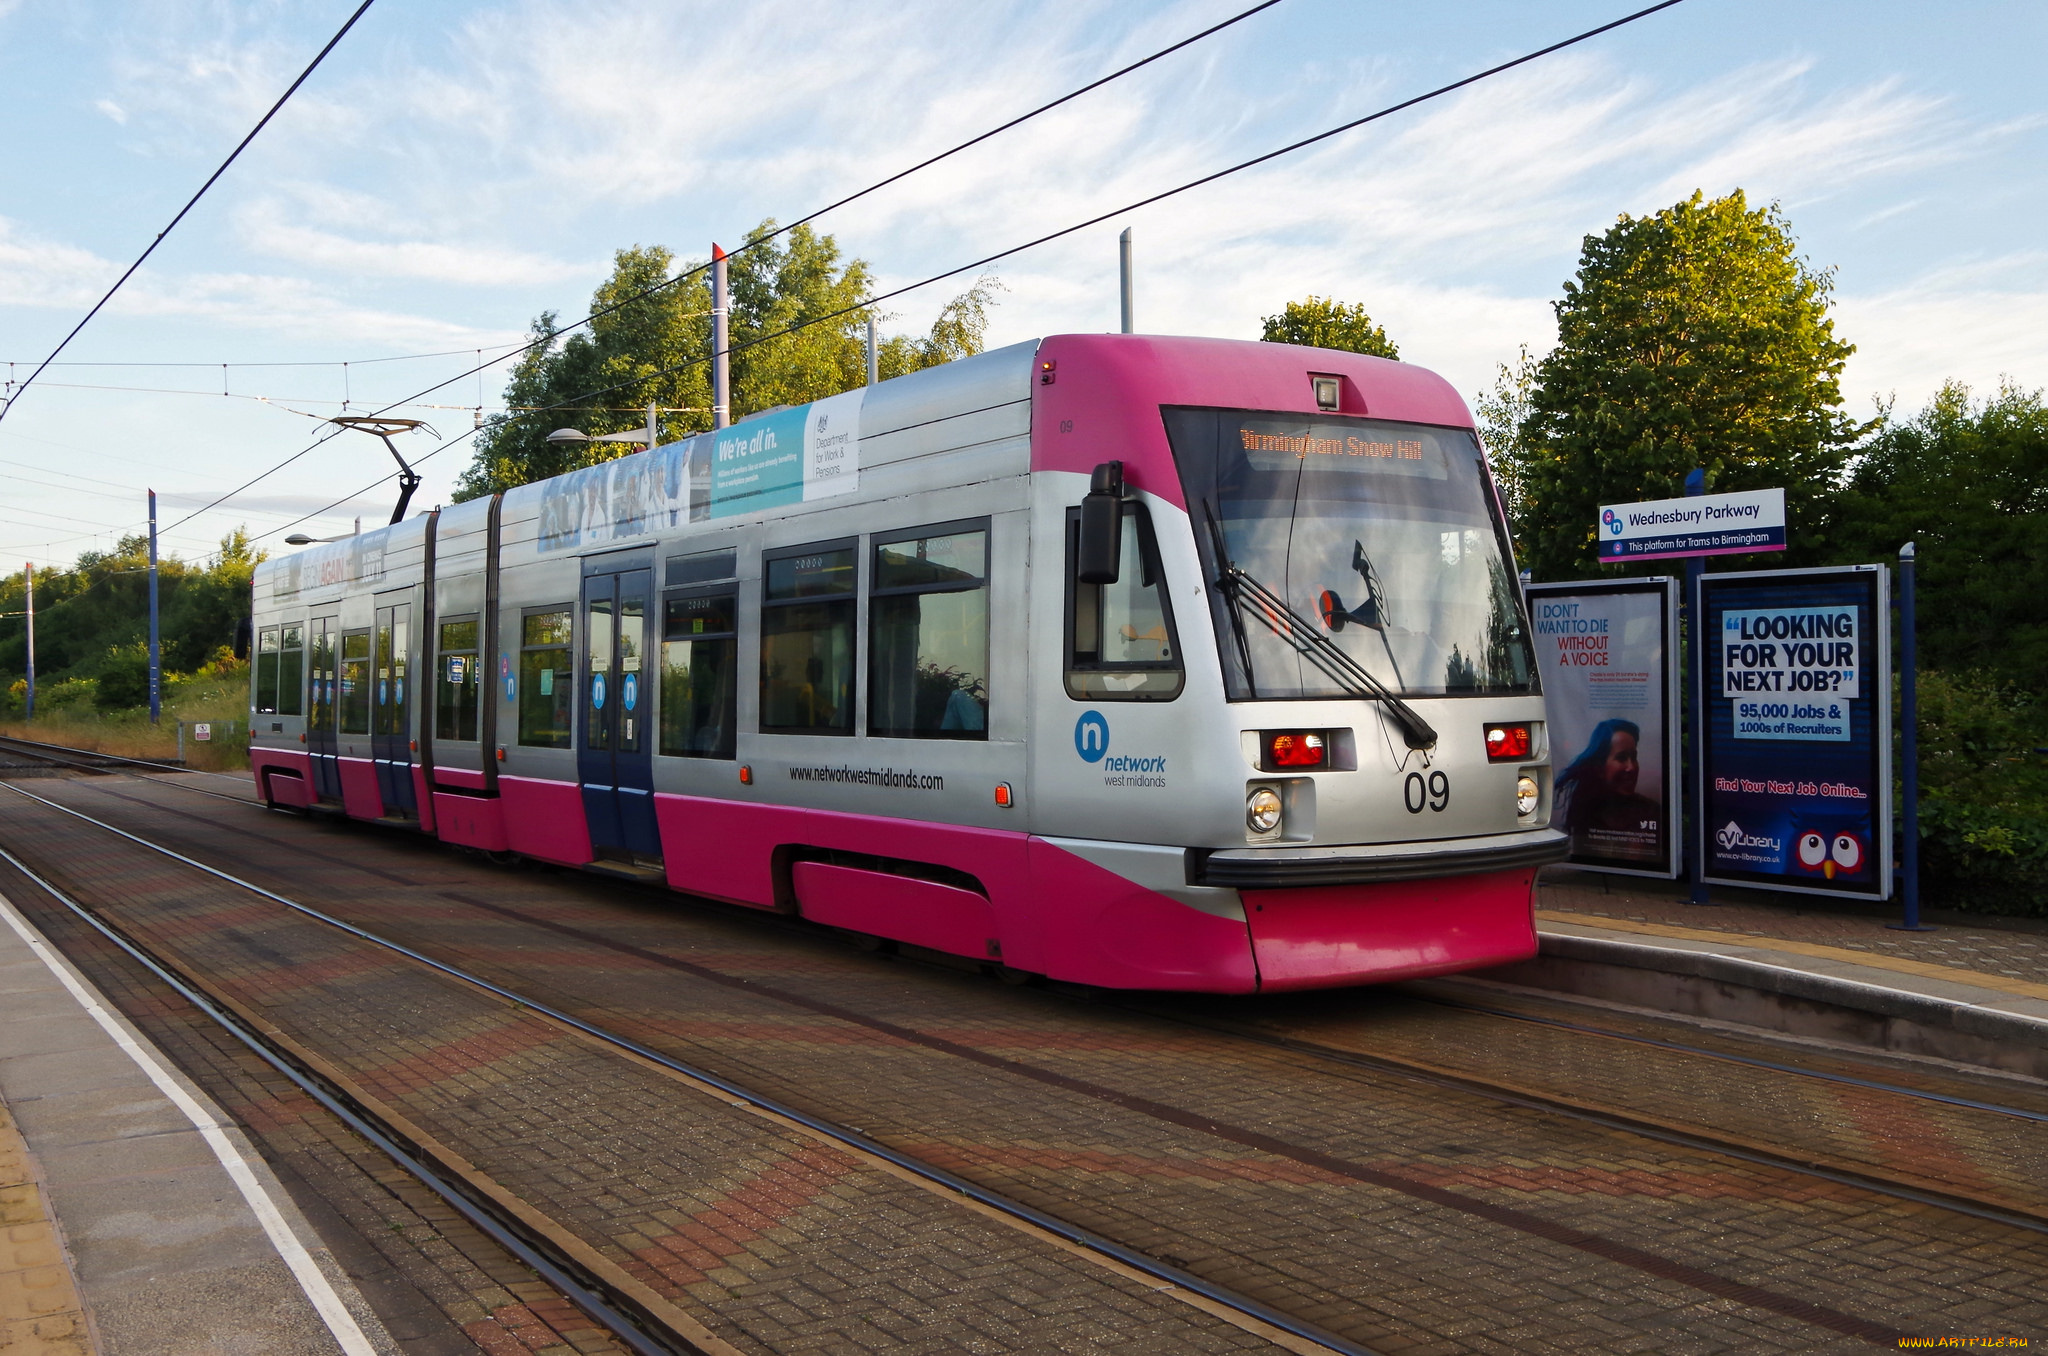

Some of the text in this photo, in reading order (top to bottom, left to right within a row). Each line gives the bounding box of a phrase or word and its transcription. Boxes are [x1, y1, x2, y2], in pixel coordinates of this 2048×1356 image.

[1060, 419, 1073, 434] 09
[719, 427, 777, 462] We're all in.
[816, 432, 849, 449] Department
[1347, 436, 1394, 458] Snow
[1397, 439, 1422, 460] Hill
[816, 447, 845, 463] for Work &
[816, 464, 841, 478] Pensions
[1629, 504, 1760, 526] Wednesbury Parkway
[1629, 532, 1769, 552] This platform for Trams to Birmingham
[1543, 604, 1579, 618] DON'T
[1537, 619, 1609, 634] WANT TO DIE
[1557, 636, 1609, 650] WITHOUT
[1560, 652, 1609, 666] A VOICE
[1726, 642, 1853, 668] FOR YOUR
[1727, 671, 1784, 692] NEXT
[1739, 704, 1841, 721] 95,000 Jobs &
[1740, 722, 1842, 735] 1000s of Recruiters
[1104, 755, 1166, 773] network
[789, 764, 944, 790] www.networkwestmidlands.com
[1104, 775, 1166, 788] west midlands
[1404, 770, 1450, 814] 09
[1716, 777, 1867, 799] Find Your Next Job Online...
[1716, 851, 1781, 864] www.cv-library.co.uk
